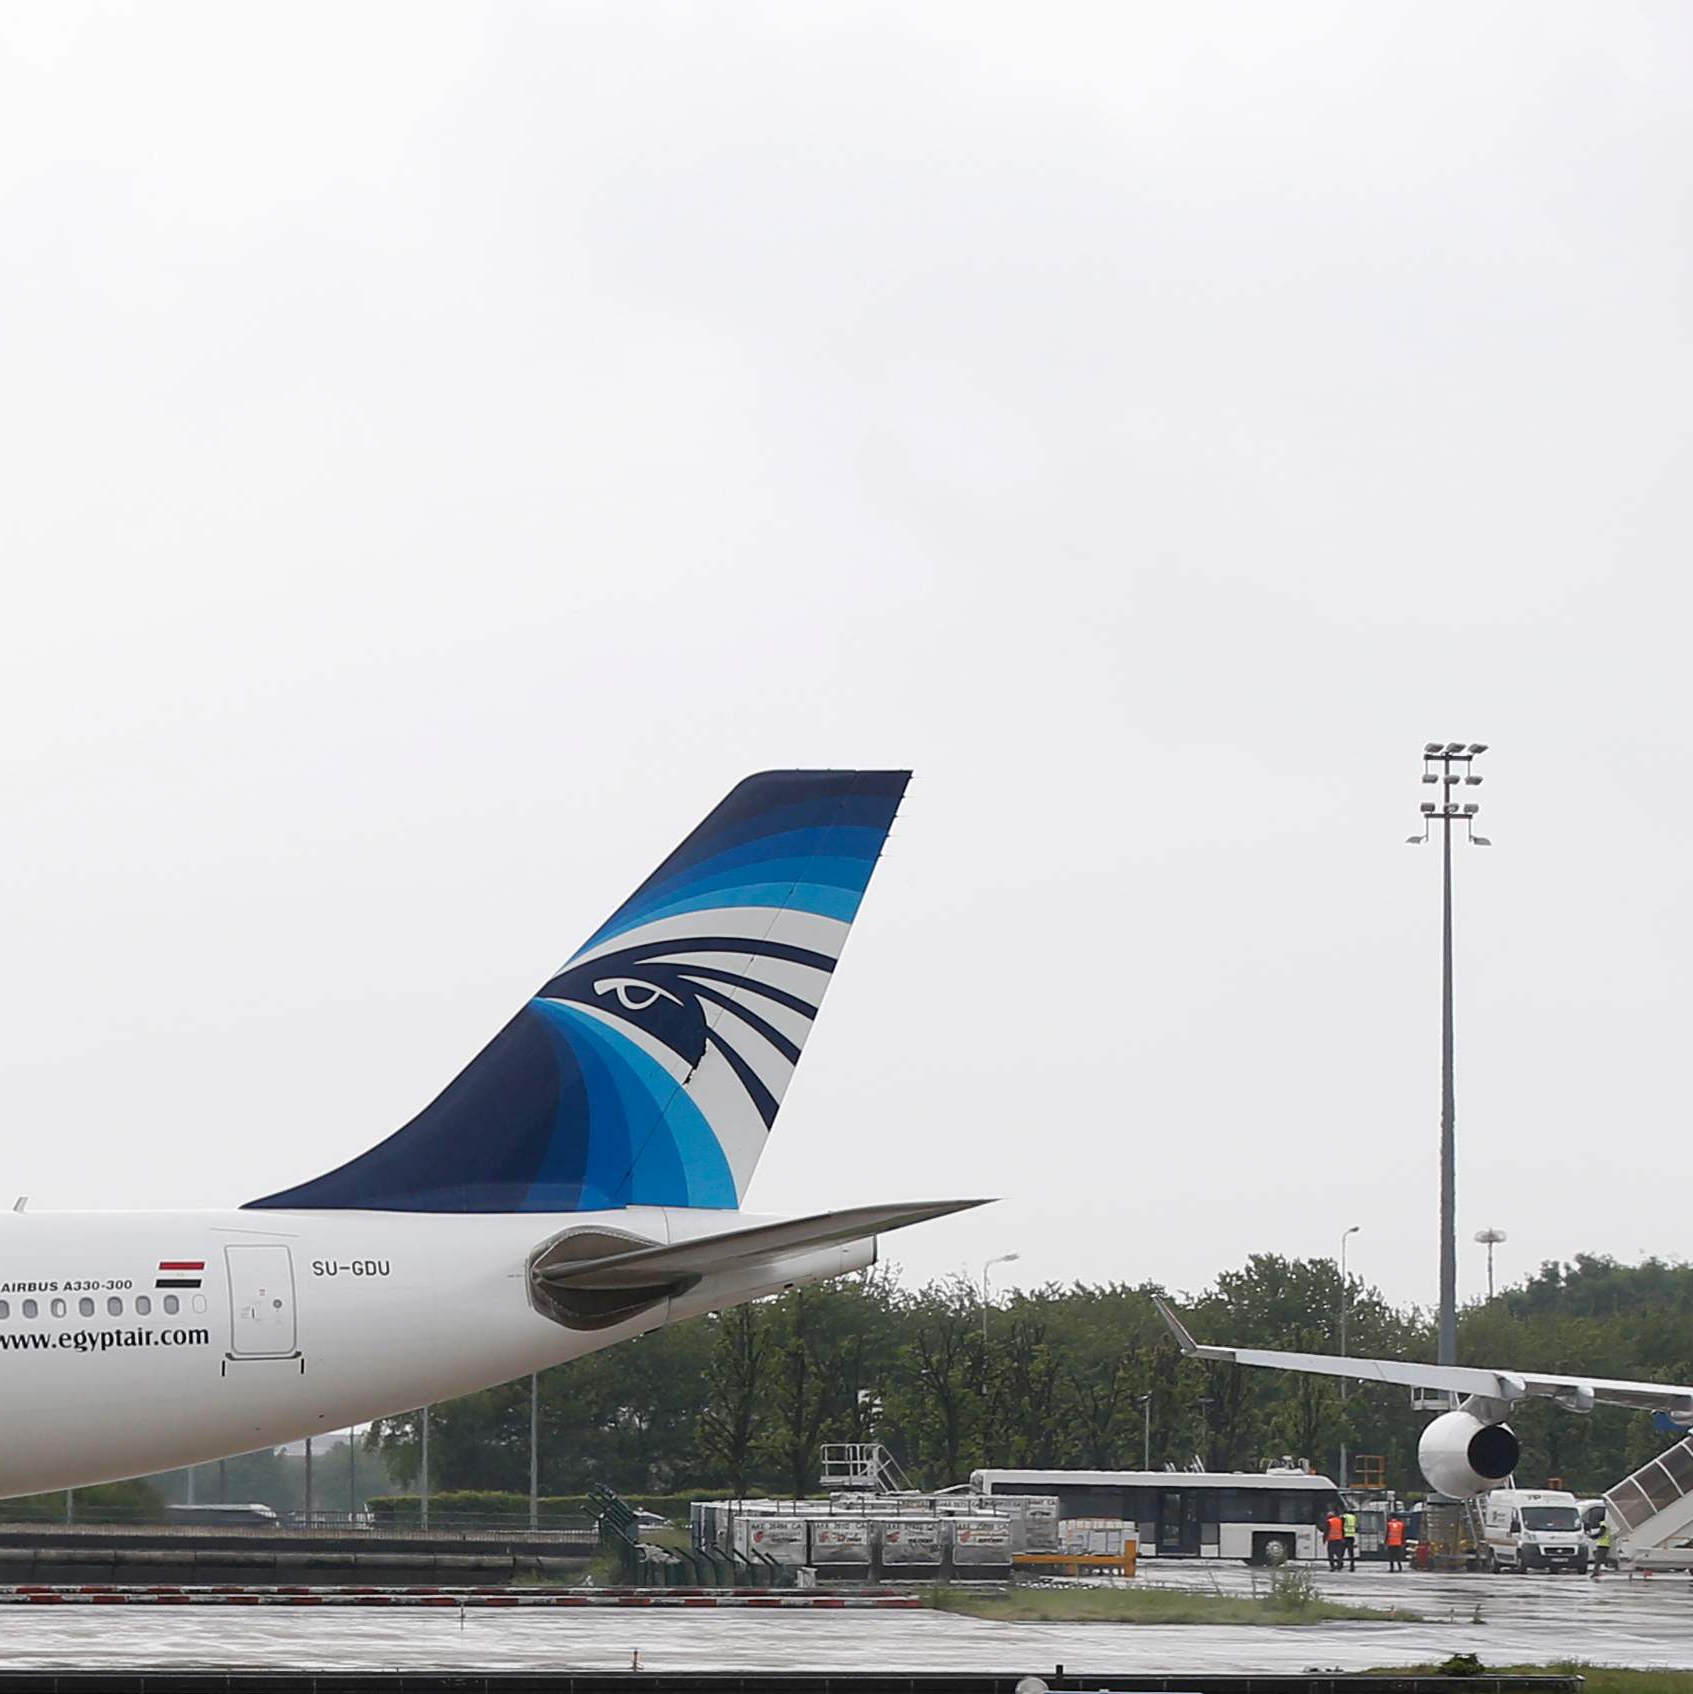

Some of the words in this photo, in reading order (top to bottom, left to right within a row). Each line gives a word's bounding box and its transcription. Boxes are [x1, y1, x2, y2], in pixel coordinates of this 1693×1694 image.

[312, 1260, 390, 1277] SU-GDU
[1, 1282, 59, 1293] AIRBUS
[63, 1279, 133, 1292] A330-300
